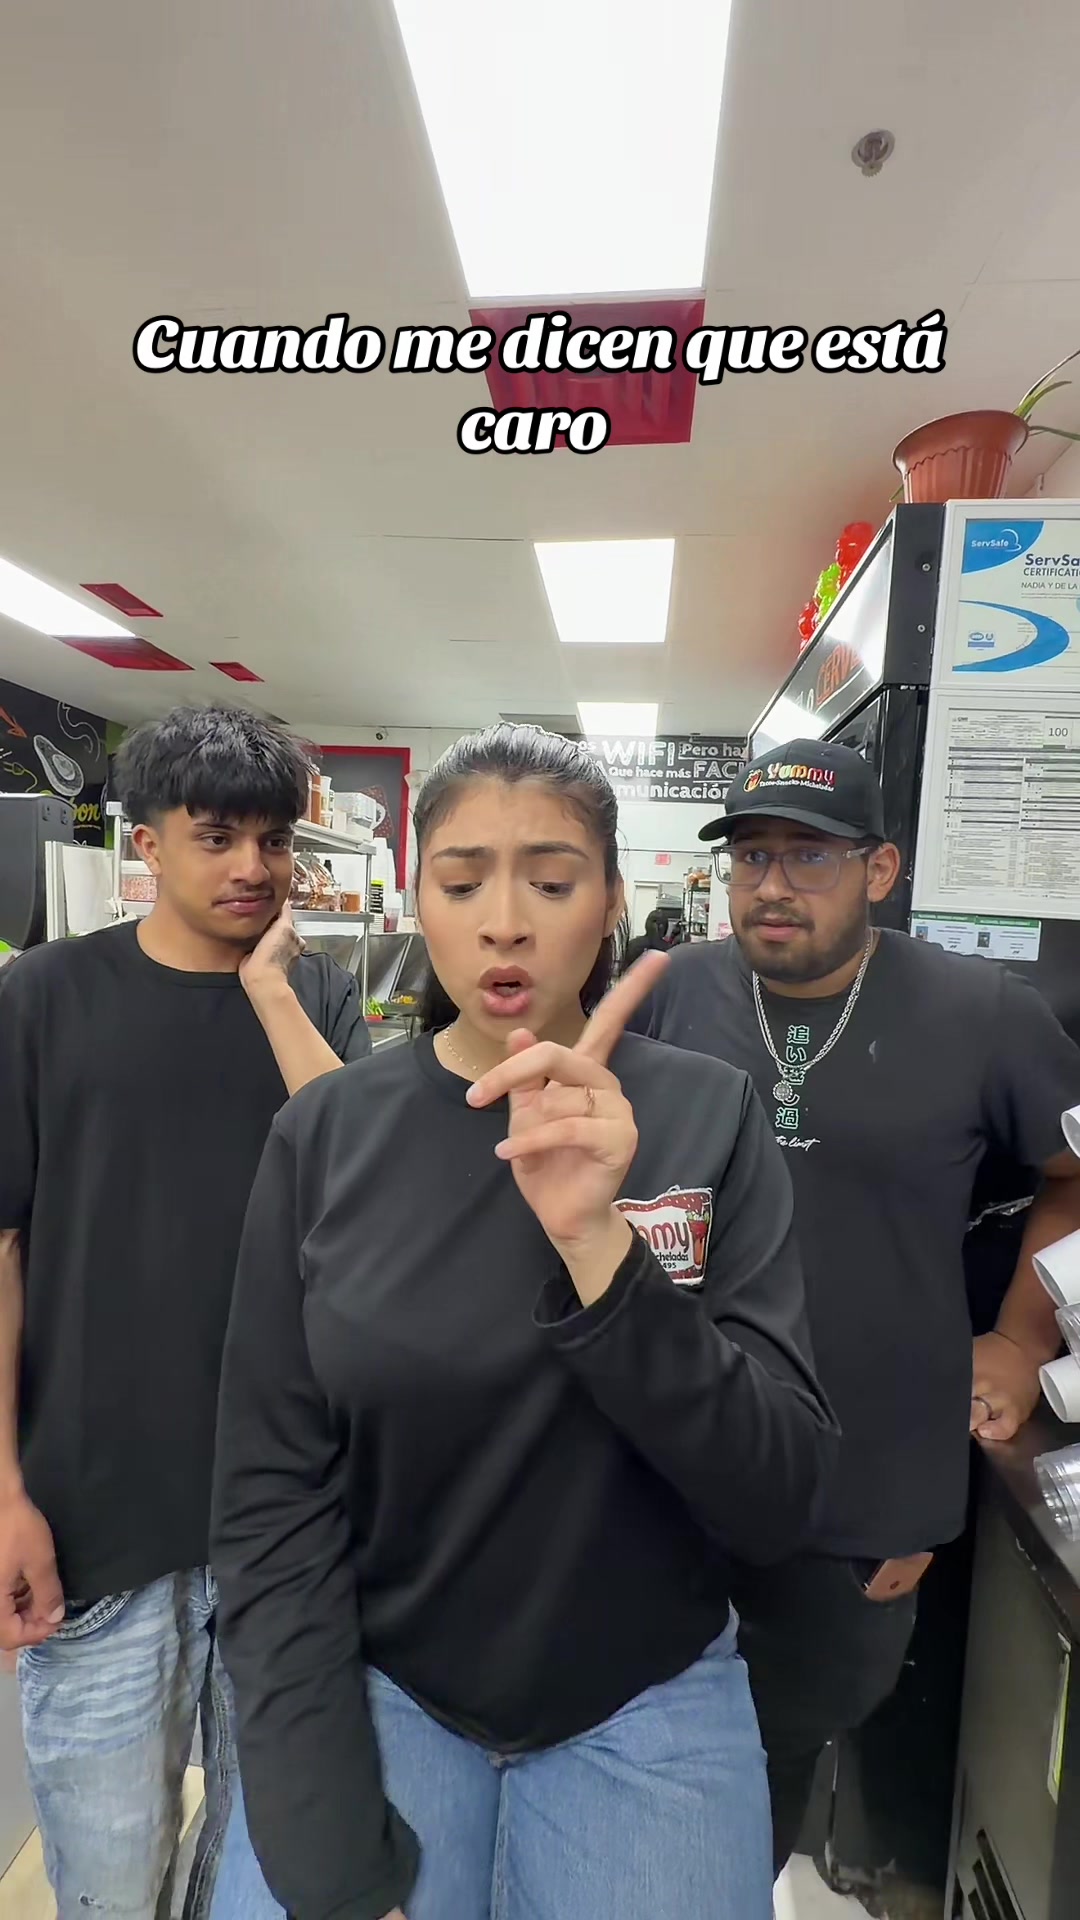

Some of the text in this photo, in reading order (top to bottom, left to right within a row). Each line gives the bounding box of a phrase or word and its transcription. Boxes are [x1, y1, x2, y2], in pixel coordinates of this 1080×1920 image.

[971, 539, 1009, 548] ServSafe
[1025, 553, 1080, 567] ServSa
[1023, 567, 1080, 577] CERTIFICATI
[1055, 582, 1066, 590] DE
[1068, 582, 1078, 590] LA
[1048, 728, 1068, 737] 100
[602, 740, 676, 767] WIFI
[681, 743, 719, 757] Pero
[609, 766, 633, 778] Que
[636, 766, 663, 778] hace
[666, 768, 692, 778] más
